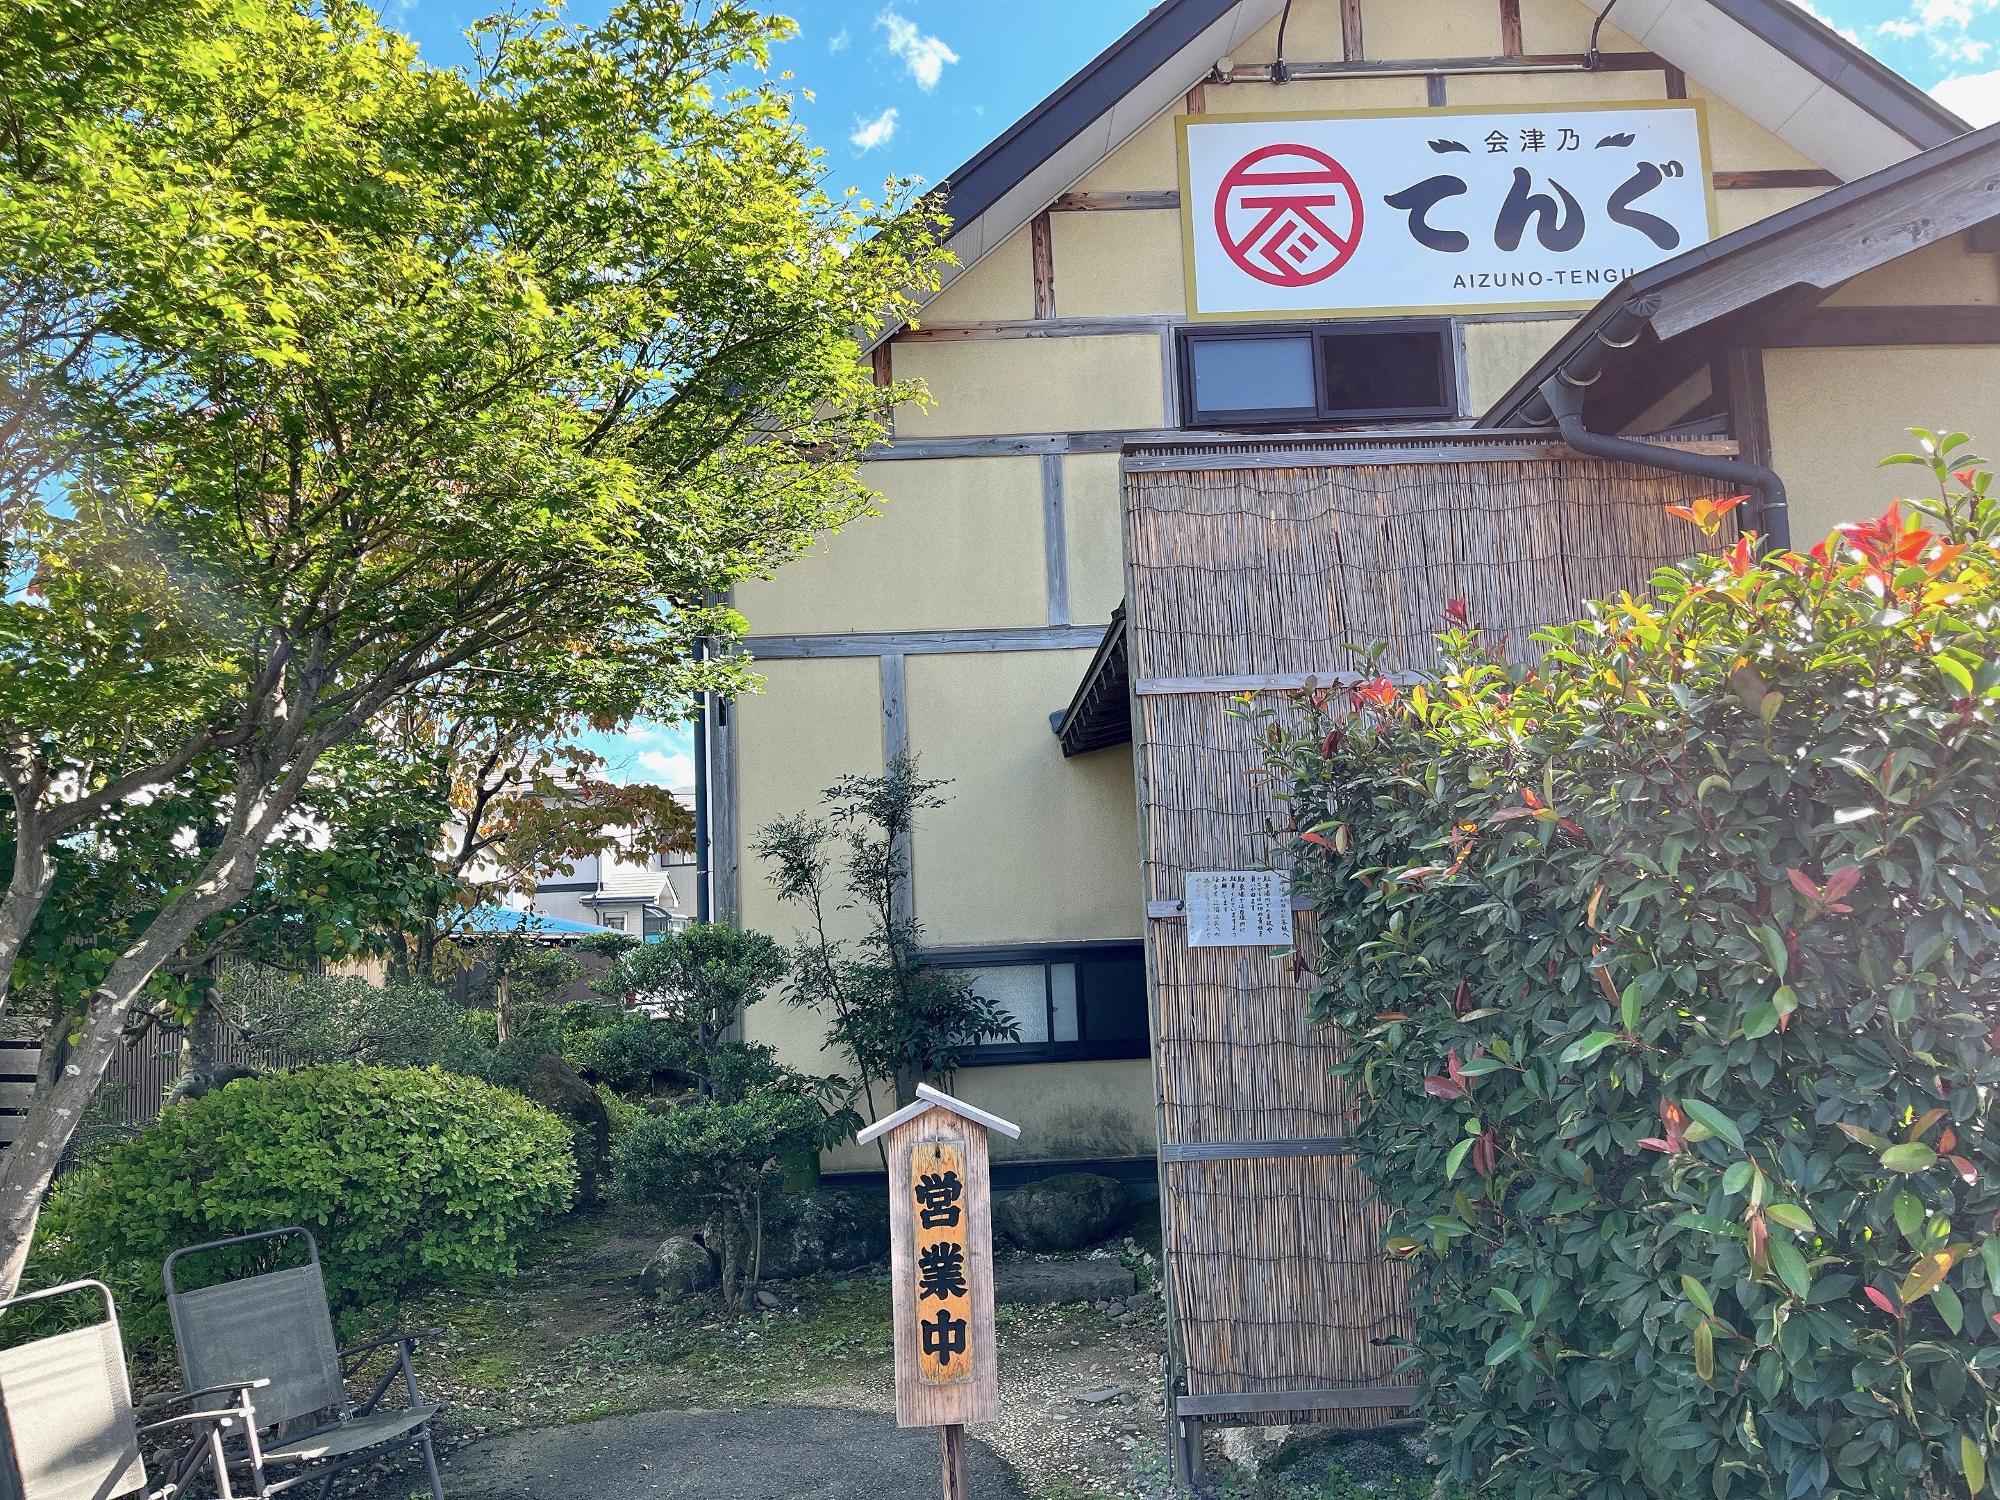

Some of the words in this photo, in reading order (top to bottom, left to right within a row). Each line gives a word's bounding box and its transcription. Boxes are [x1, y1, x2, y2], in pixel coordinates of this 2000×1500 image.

[1483, 127, 1580, 154] 会津乃
[1383, 160, 1684, 253] てんぐ
[914, 1170, 968, 1366] 営業中
